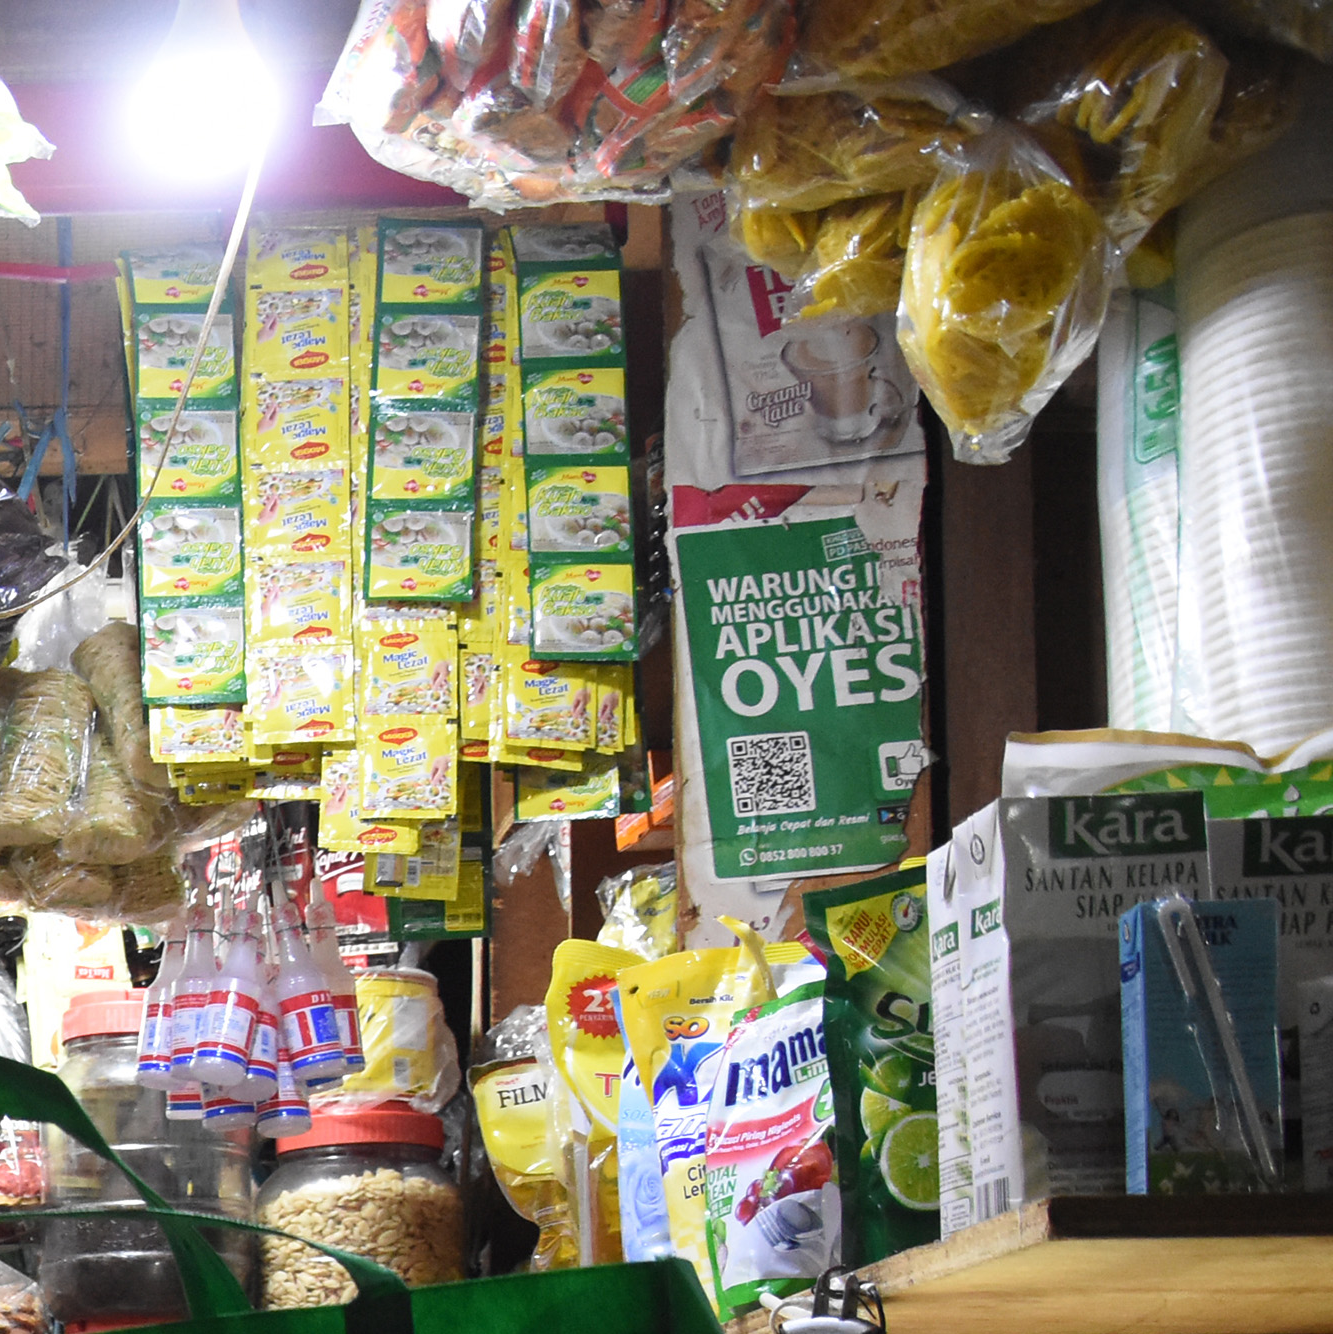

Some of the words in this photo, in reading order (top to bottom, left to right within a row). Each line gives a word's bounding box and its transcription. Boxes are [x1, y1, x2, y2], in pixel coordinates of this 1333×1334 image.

[745, 381, 813, 411] Creamy
[281, 421, 313, 434] Lezat
[291, 427, 327, 441] Magic
[706, 563, 857, 604] WARUNG
[711, 588, 907, 626] MENGGUNAKA
[715, 606, 914, 660] APLIKASI
[382, 649, 418, 664] Magic
[396, 655, 429, 670] Lezat
[524, 676, 559, 690] Magic
[538, 683, 569, 696] Lezat
[720, 642, 923, 718] OYES
[381, 744, 416, 759] Magic
[395, 750, 428, 766] Lezat
[895, 776, 916, 788] Oye
[736, 819, 777, 836] Belanja
[779, 819, 811, 834] Cepat
[814, 816, 836, 828] dan
[837, 812, 871, 826] Resmi
[1065, 799, 1191, 856] kara
[759, 850, 786, 863] 0852
[829, 843, 844, 856] 37
[1025, 864, 1113, 893] SANTAN
[1126, 859, 1199, 888] KELAPA
[1076, 894, 1123, 919] SIAP
[844, 911, 873, 948] BARU!
[689, 996, 717, 1005] Bersih
[663, 1016, 710, 1041] SO
[795, 1059, 828, 1084] Lim
[496, 1081, 547, 1109] FILM
[741, 1126, 767, 1143] Piring
